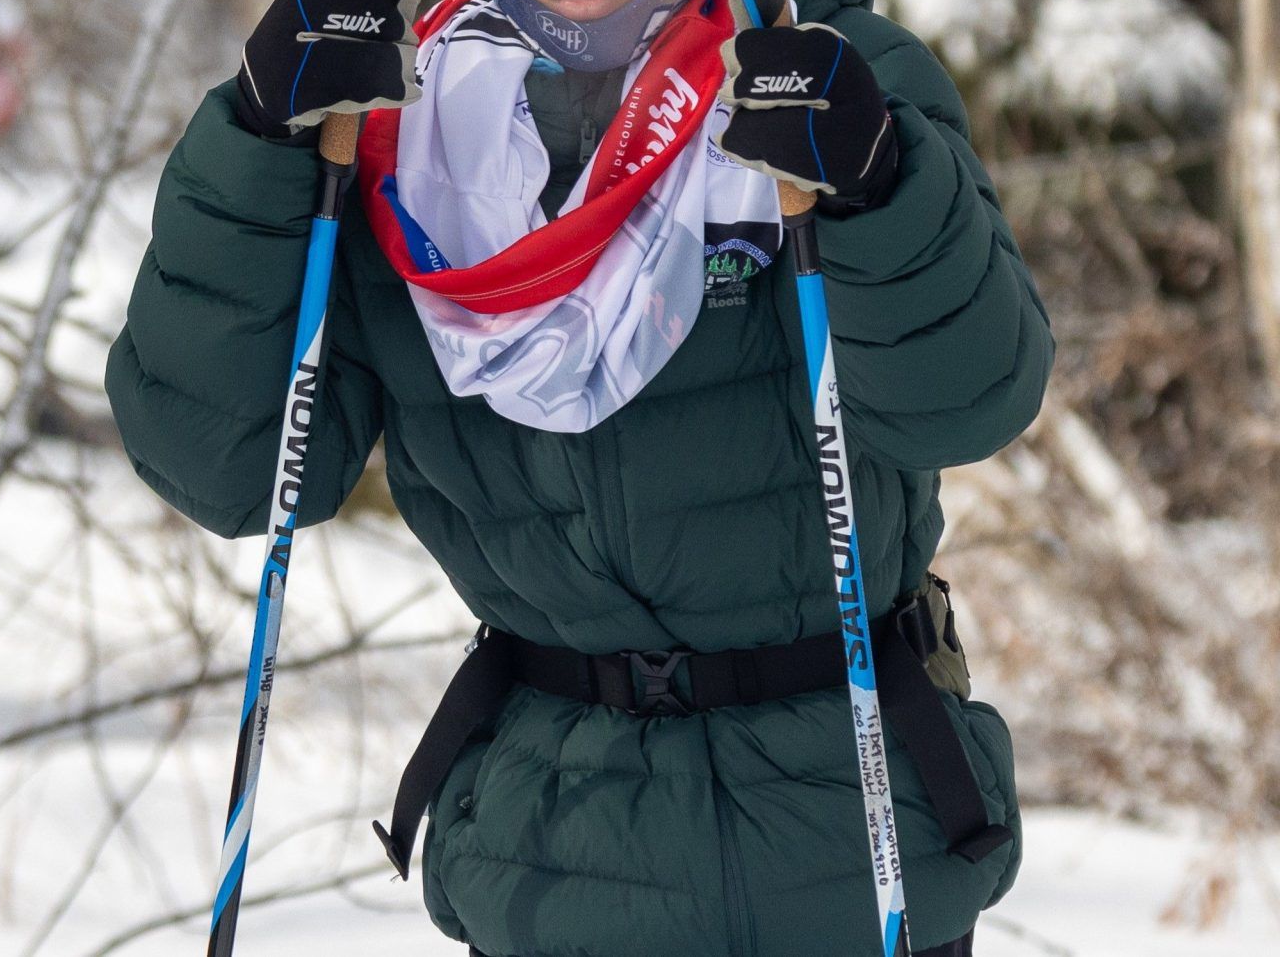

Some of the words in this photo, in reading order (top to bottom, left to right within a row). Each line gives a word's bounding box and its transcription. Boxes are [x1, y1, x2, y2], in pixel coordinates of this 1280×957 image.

[614, 86, 643, 167] DÉCOUVRIR
[706, 297, 747, 309] Roots
[815, 423, 869, 671] SALOMON
